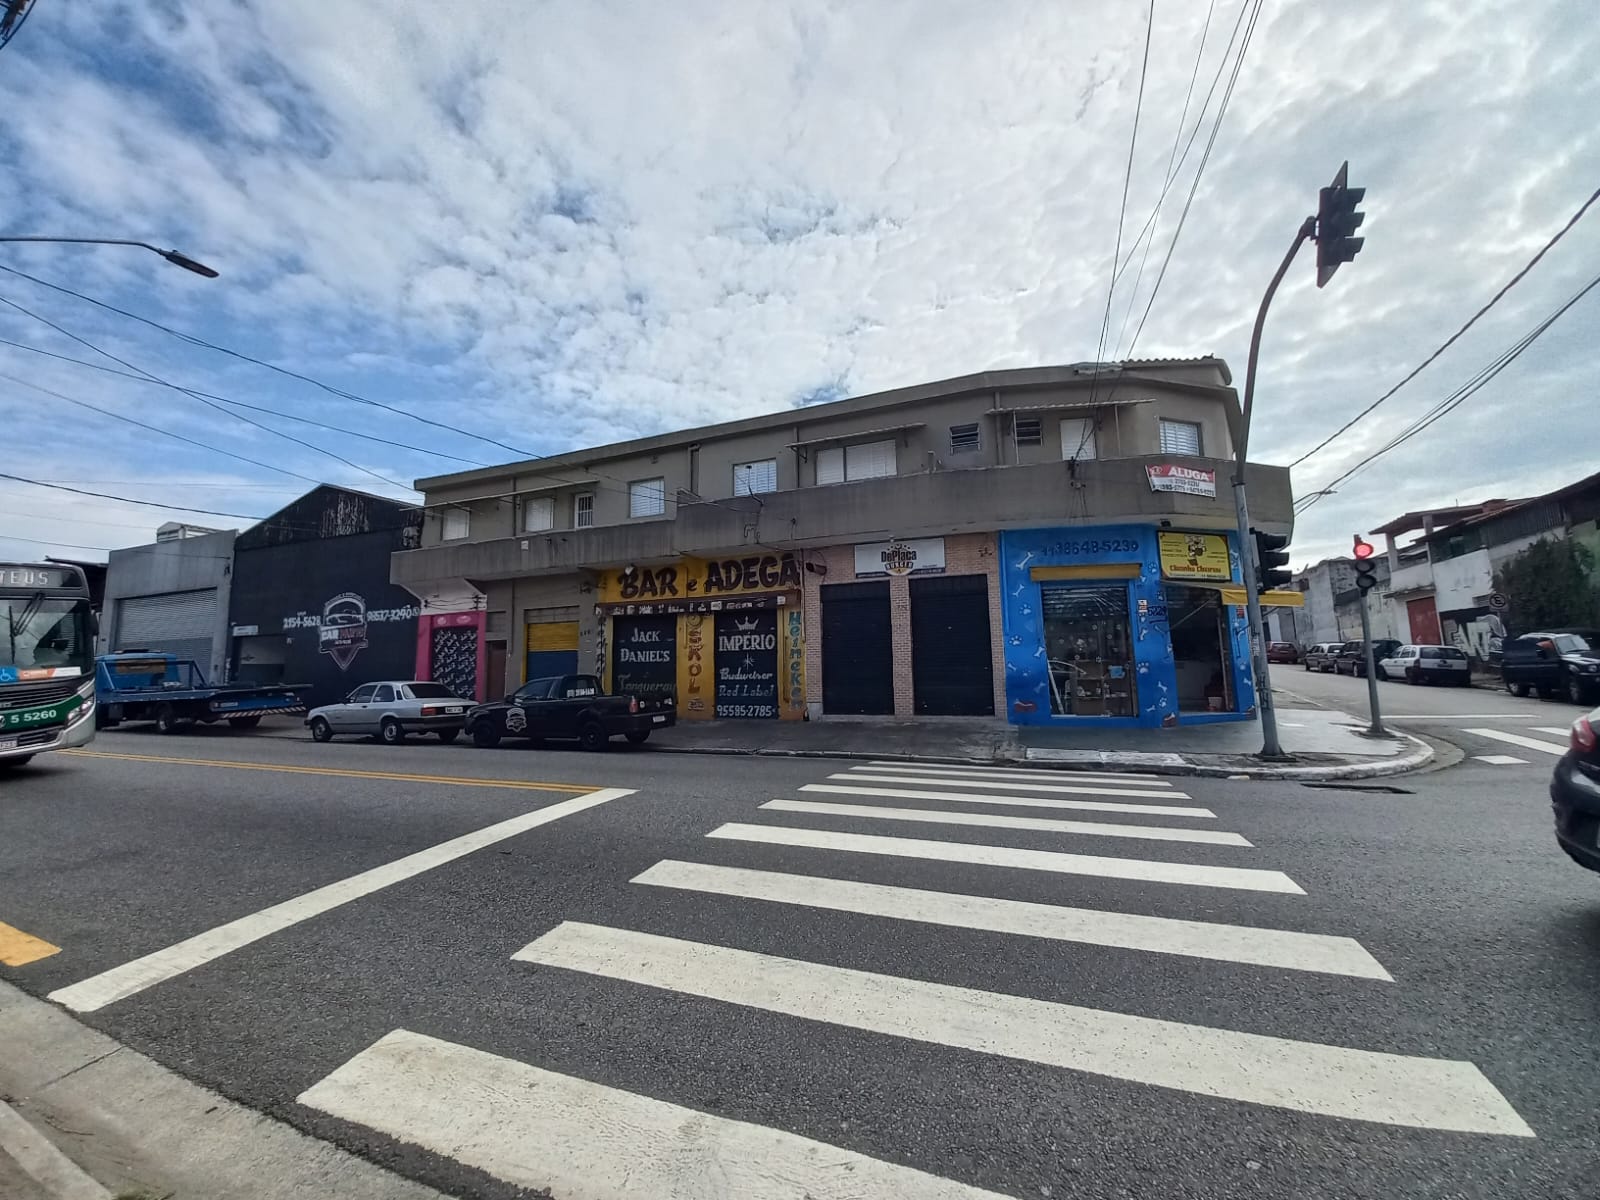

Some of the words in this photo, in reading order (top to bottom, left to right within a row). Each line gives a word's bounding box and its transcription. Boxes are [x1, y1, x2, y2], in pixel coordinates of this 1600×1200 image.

[1168, 466, 1210, 482] ALUGA
[617, 565, 679, 599] BAR
[687, 579, 698, 592] e
[704, 553, 801, 592] ADEGA
[321, 629, 339, 640] CAR
[719, 631, 776, 652] IMPÉRIO
[719, 667, 773, 681] Budweiser
[719, 684, 740, 698] Red
[742, 684, 775, 698] Label
[11, 714, 20, 724] 5
[24, 709, 57, 722] 5260
